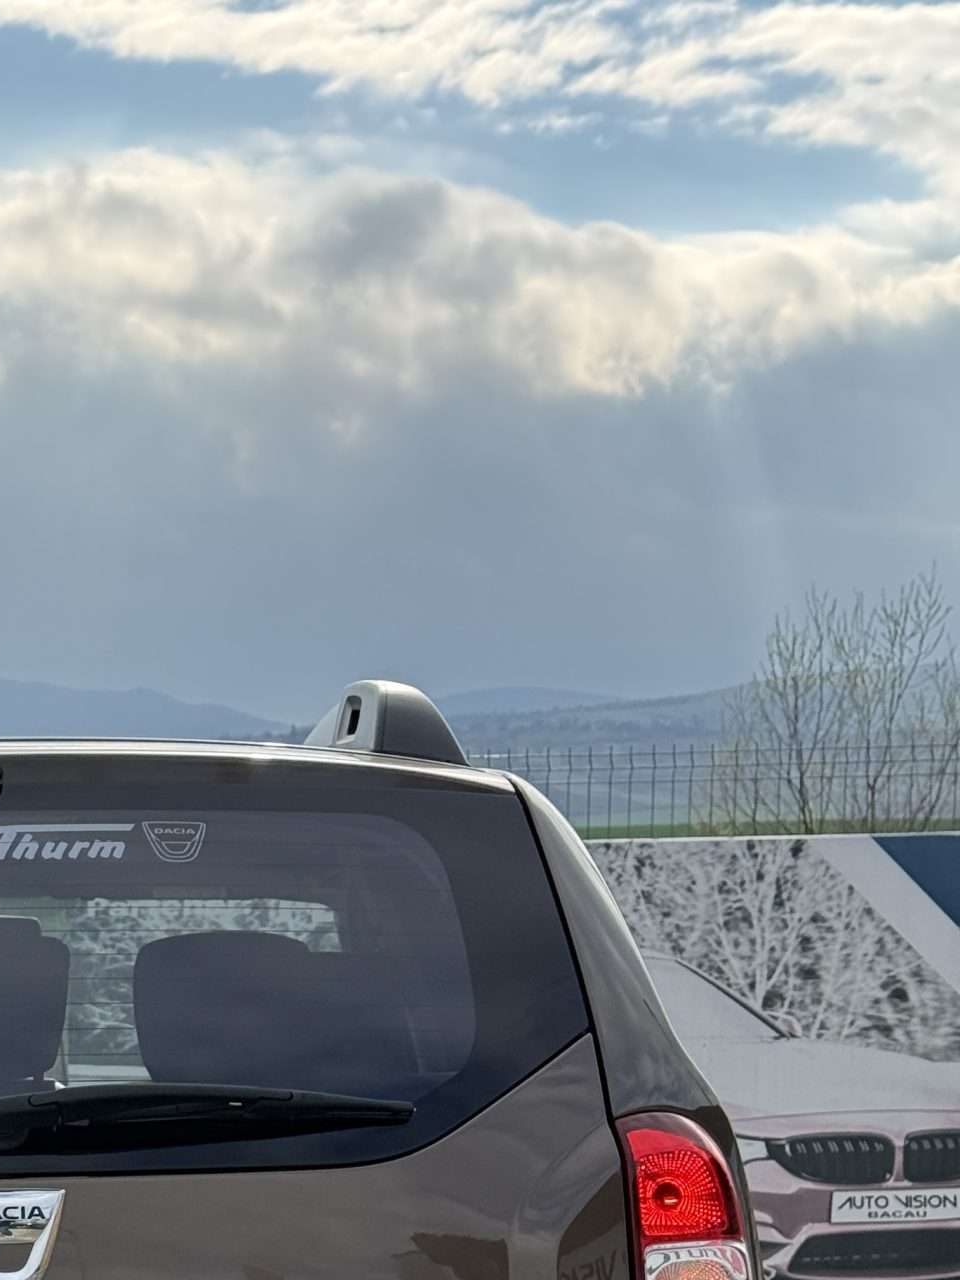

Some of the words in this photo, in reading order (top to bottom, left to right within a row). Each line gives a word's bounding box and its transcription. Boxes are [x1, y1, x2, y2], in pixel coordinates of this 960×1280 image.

[154, 827, 196, 835] DACIA
[837, 1194, 890, 1210] AUTO
[894, 1194, 958, 1209] VISION
[867, 1210, 928, 1219] BACAU
